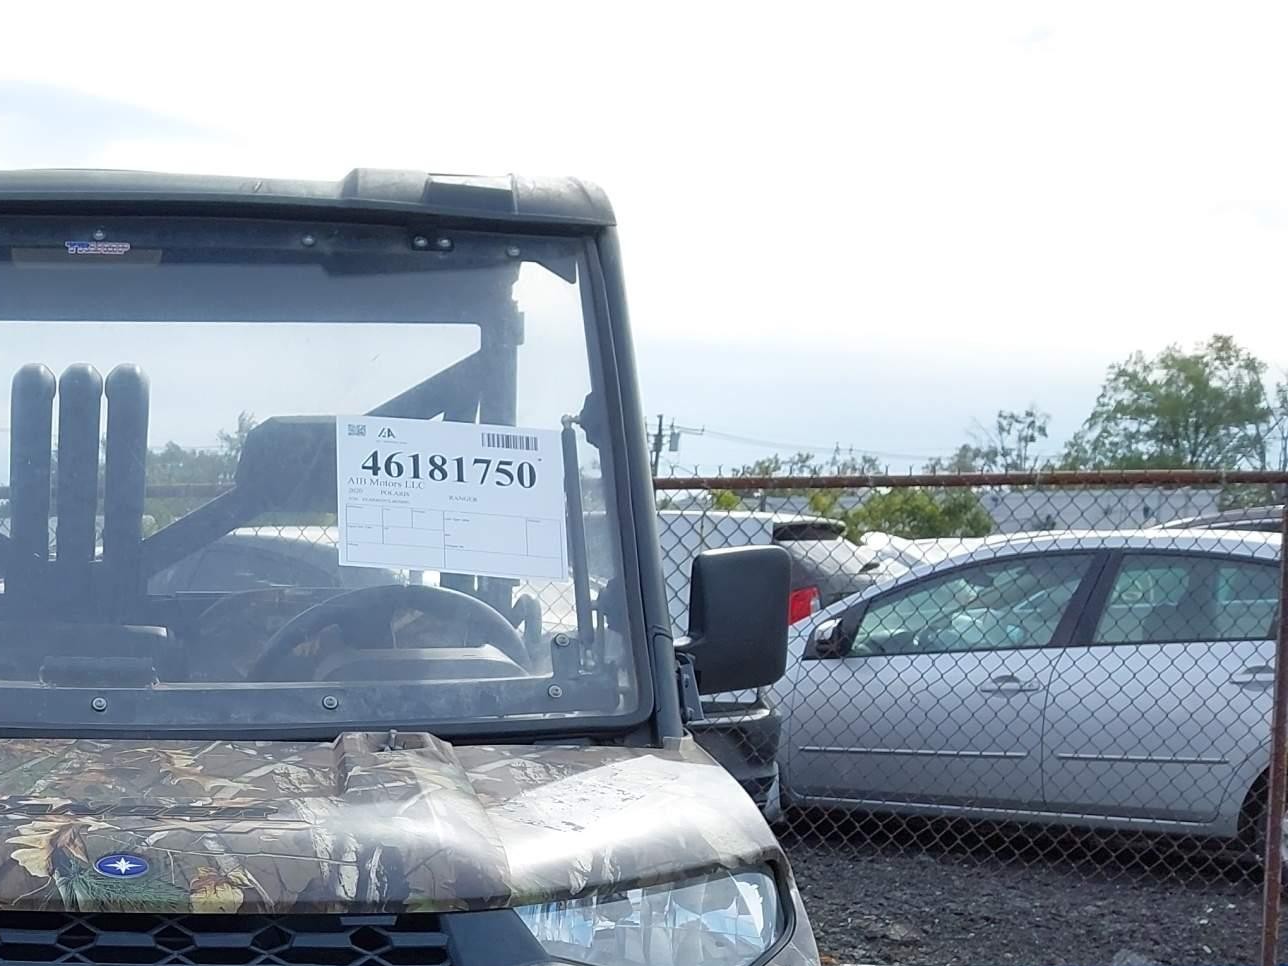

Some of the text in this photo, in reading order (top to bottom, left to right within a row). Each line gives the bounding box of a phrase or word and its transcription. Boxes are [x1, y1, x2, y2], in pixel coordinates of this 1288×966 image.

[361, 450, 537, 489] 46181750
[369, 478, 402, 488] Motors
[405, 479, 425, 490] LLC
